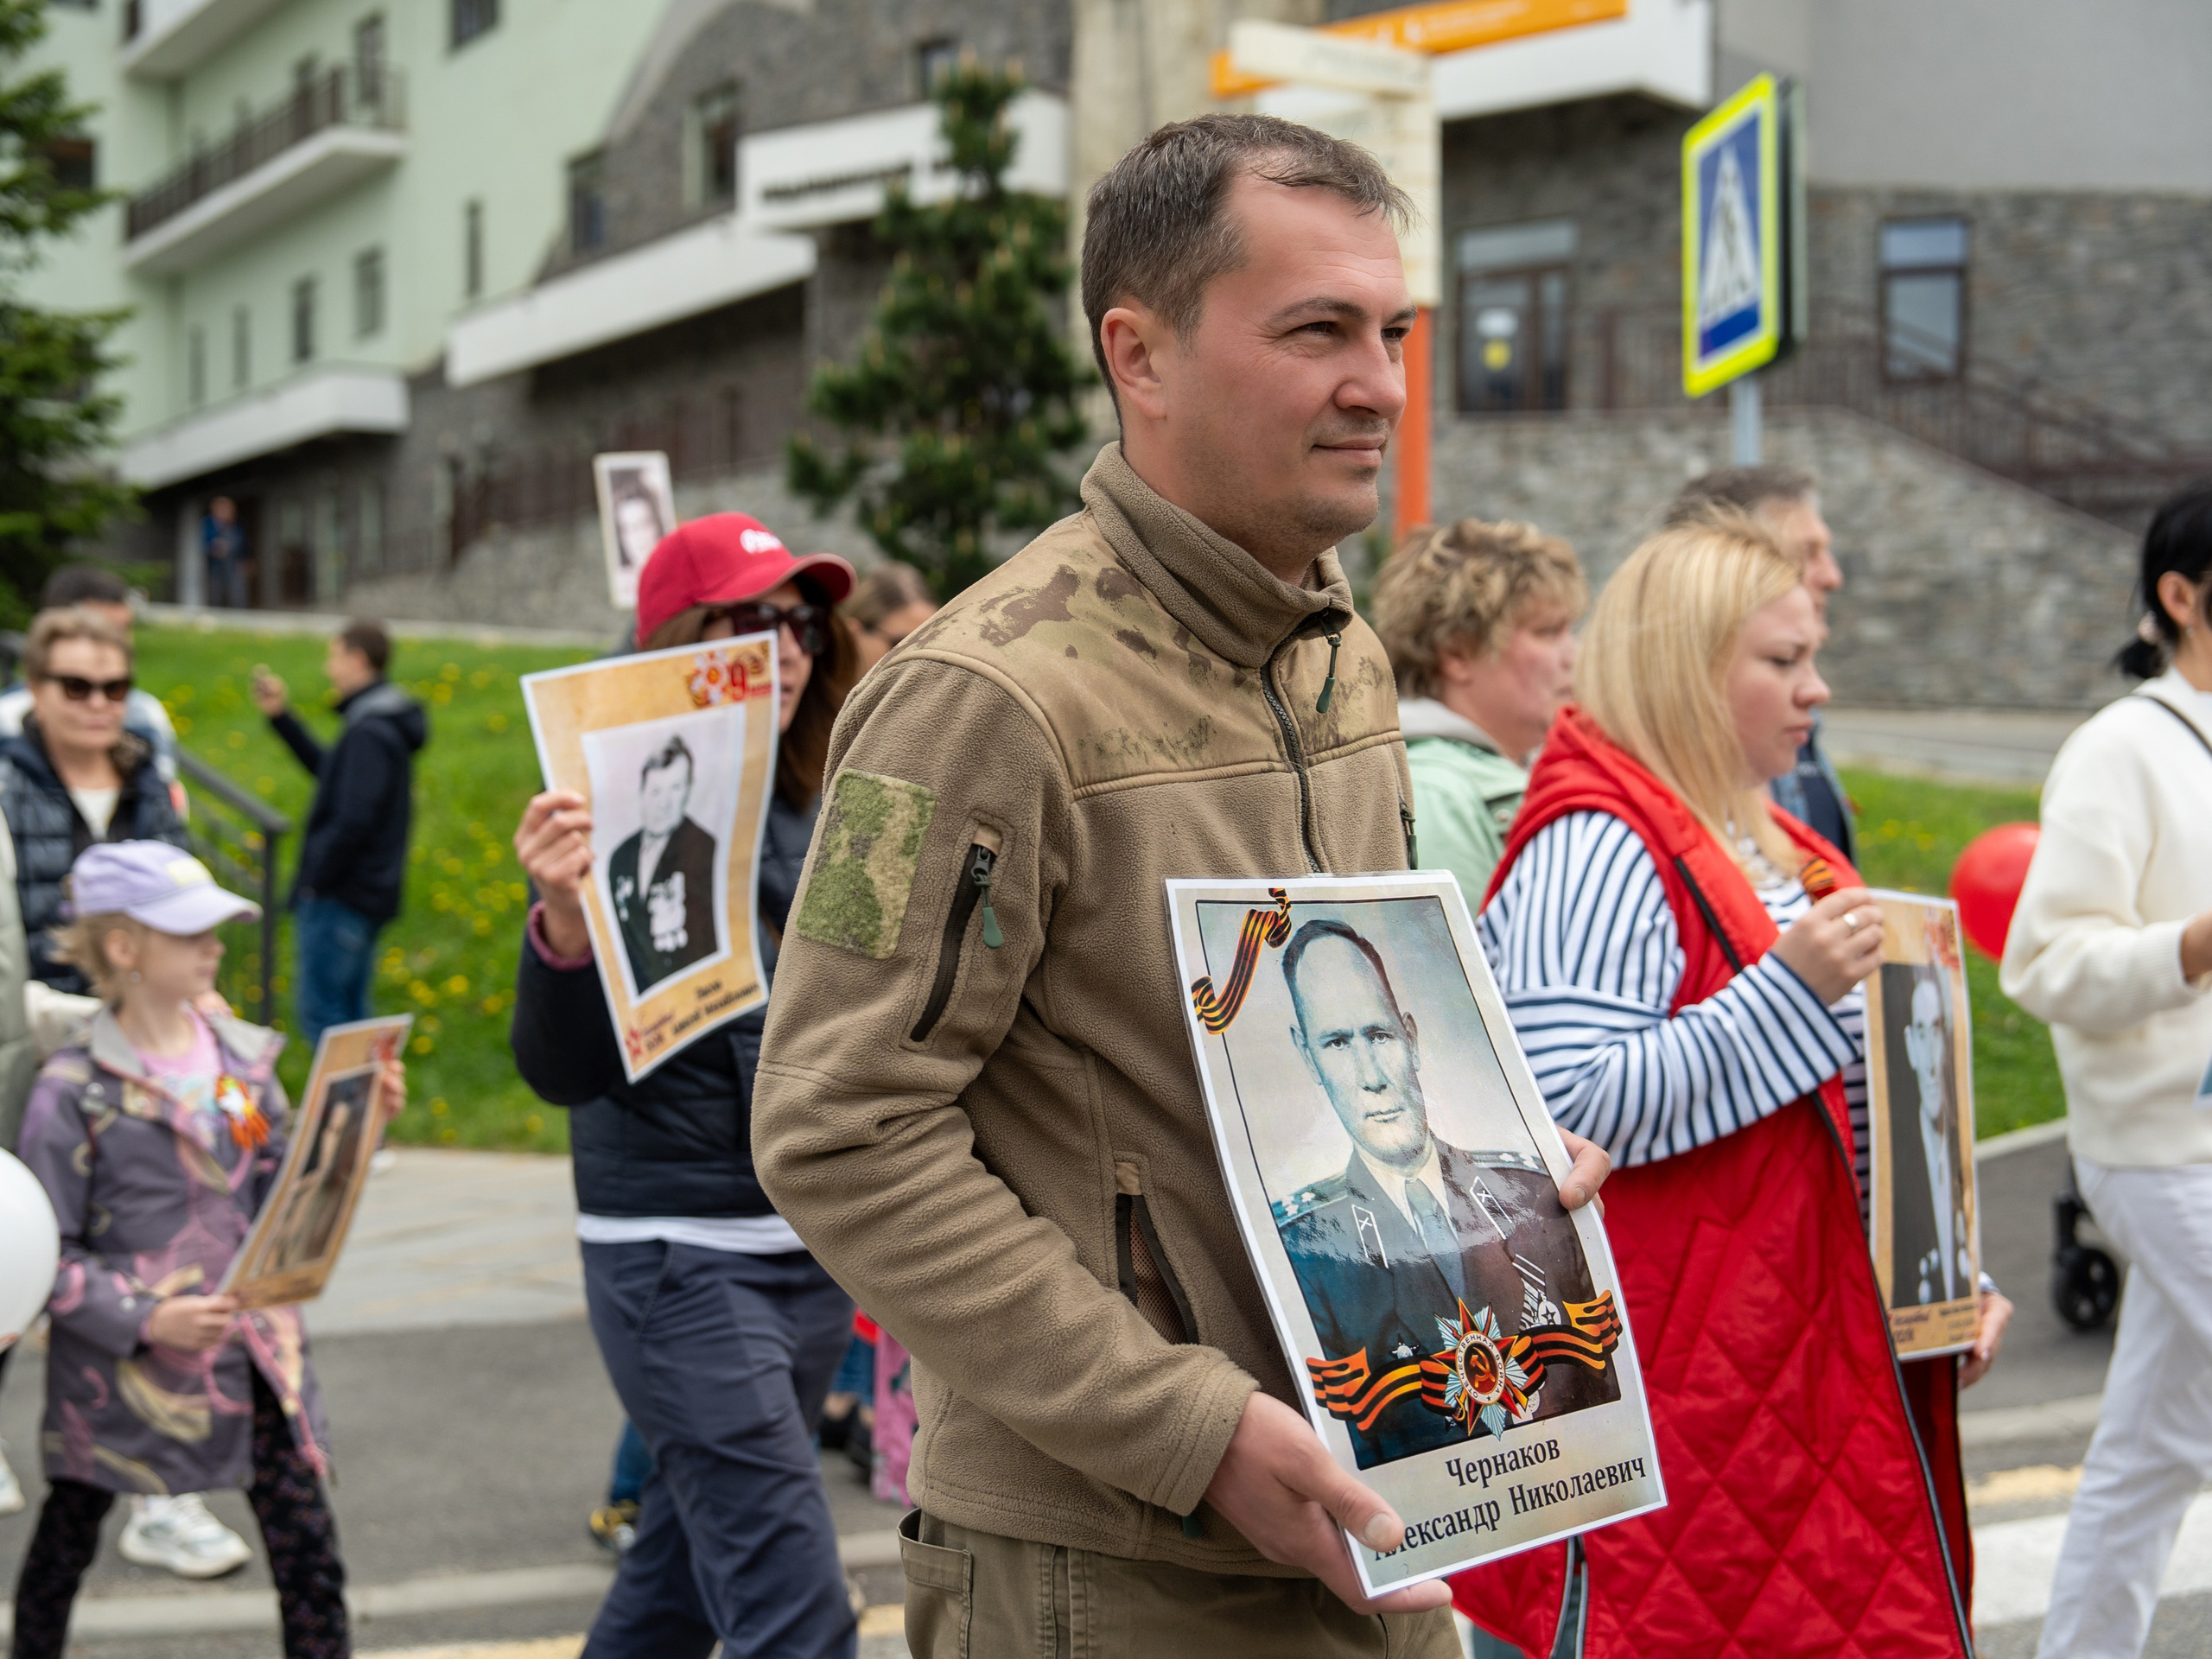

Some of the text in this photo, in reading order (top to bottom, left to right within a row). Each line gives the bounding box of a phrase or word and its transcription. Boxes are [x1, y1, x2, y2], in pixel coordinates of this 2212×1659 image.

[1458, 1334, 1494, 1399] ОТЕЧЕСТВЕННАЯ
[1445, 1438, 1560, 1488] Чернаков
[1374, 1457, 1646, 1560] ександр Николаевич
